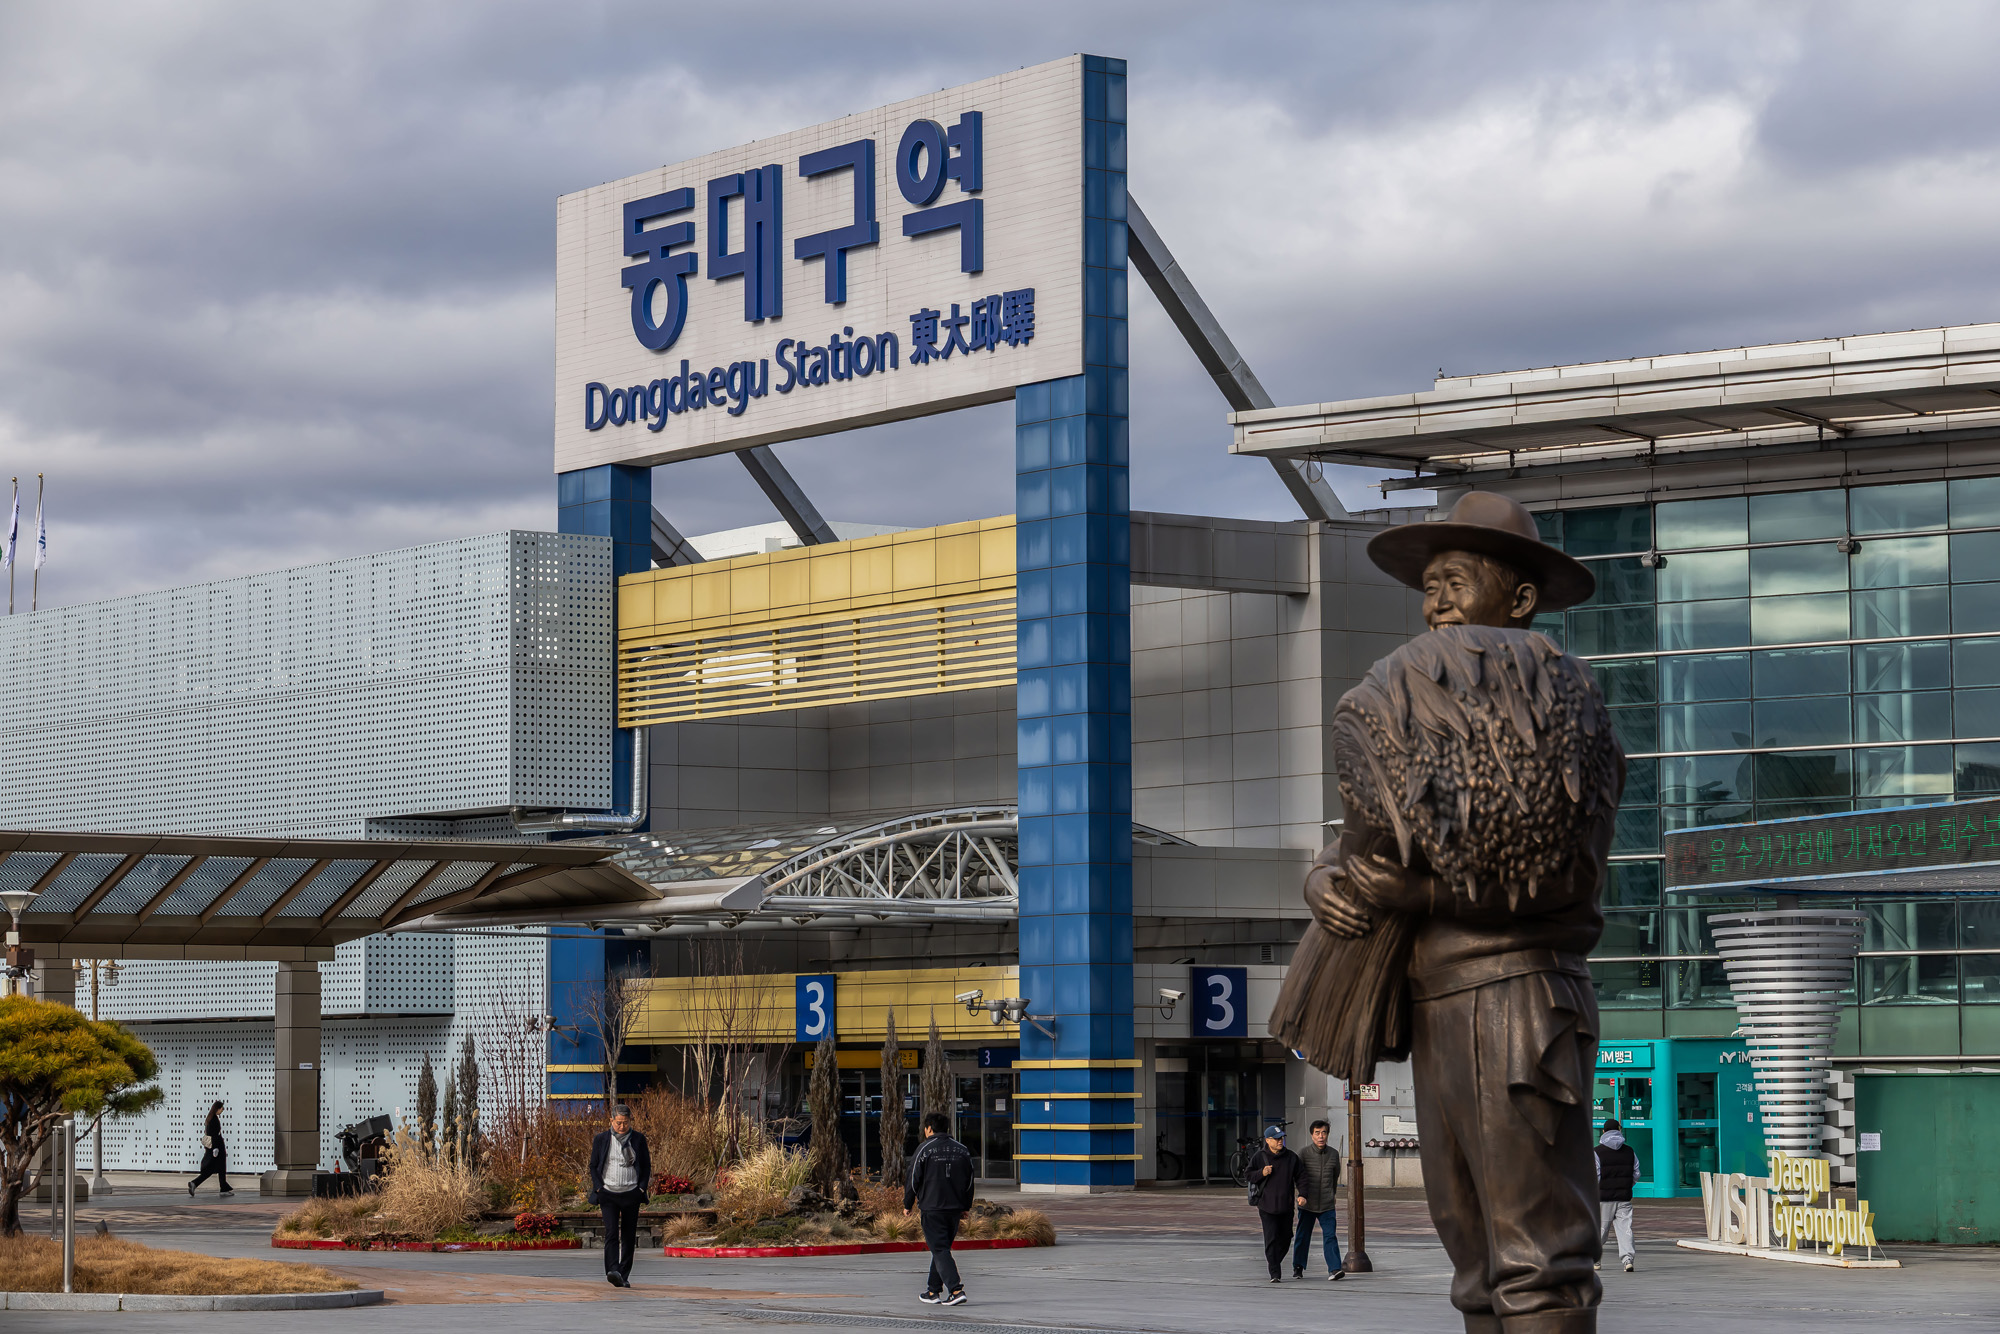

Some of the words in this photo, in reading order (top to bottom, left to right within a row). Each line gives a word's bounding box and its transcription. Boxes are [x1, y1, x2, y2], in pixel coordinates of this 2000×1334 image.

[621, 110, 983, 351] 동대구역
[585, 358, 769, 432] Dongdaegu
[775, 326, 898, 393] Station
[909, 287, 1035, 365] 東大邱驛
[1735, 828, 1833, 870] 수거거점에
[1843, 819, 1927, 860] 가져오면
[804, 981, 826, 1036] 3
[1205, 974, 1235, 1031] 3
[984, 1049, 991, 1066] 3
[1601, 1050, 1634, 1064] iM뱅크
[1361, 1085, 1377, 1093] 연구역
[1771, 1150, 1829, 1204] Daegu
[1699, 1171, 1773, 1248] VISIT
[1772, 1195, 1877, 1256] Gyeongbuk
